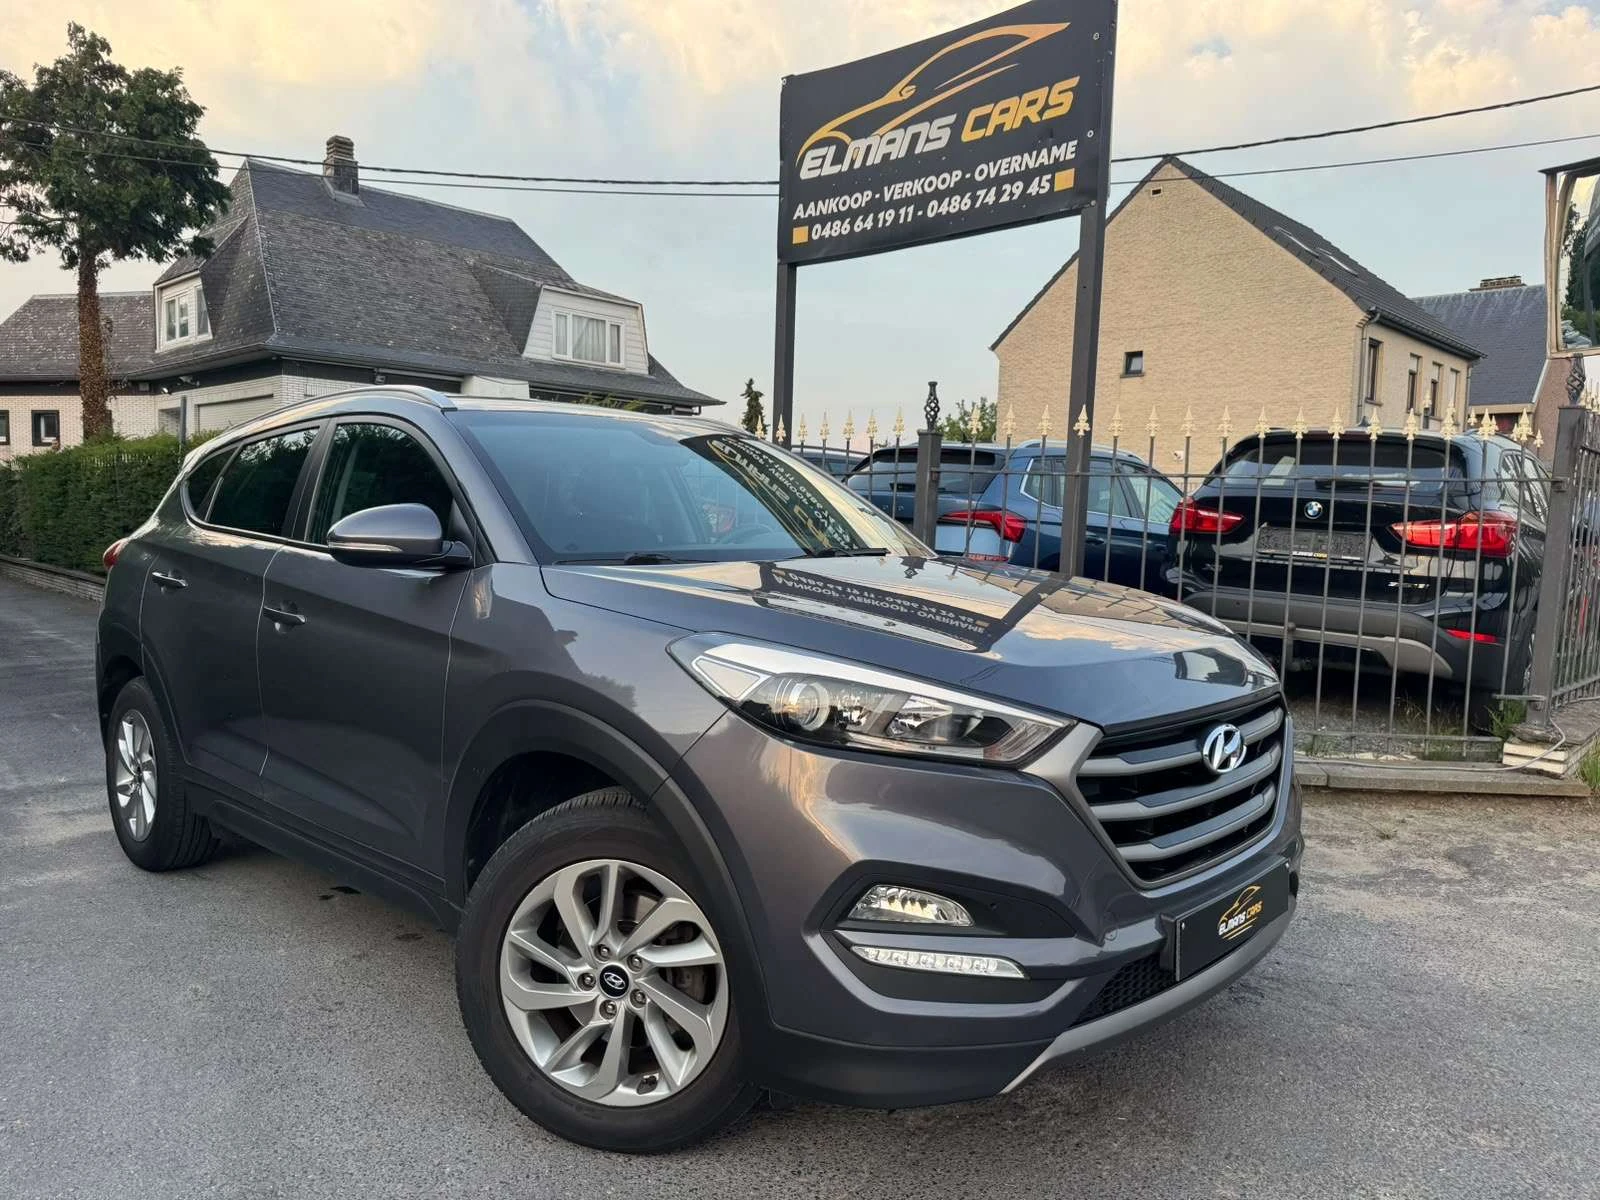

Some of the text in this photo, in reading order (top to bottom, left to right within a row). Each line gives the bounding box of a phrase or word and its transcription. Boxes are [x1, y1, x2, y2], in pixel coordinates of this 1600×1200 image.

[799, 76, 1080, 180] ELMANS CARS
[792, 190, 872, 220] AANKOOP
[883, 170, 962, 202] VERKOOP
[974, 140, 1078, 182] OVERNAME
[811, 218, 851, 240] 0486
[853, 213, 874, 232] 64
[877, 208, 896, 228] 19
[898, 204, 914, 223] 11
[926, 192, 972, 218] 0486
[974, 187, 997, 208] 74
[999, 180, 1024, 203] 29
[1026, 174, 1052, 196] 45
